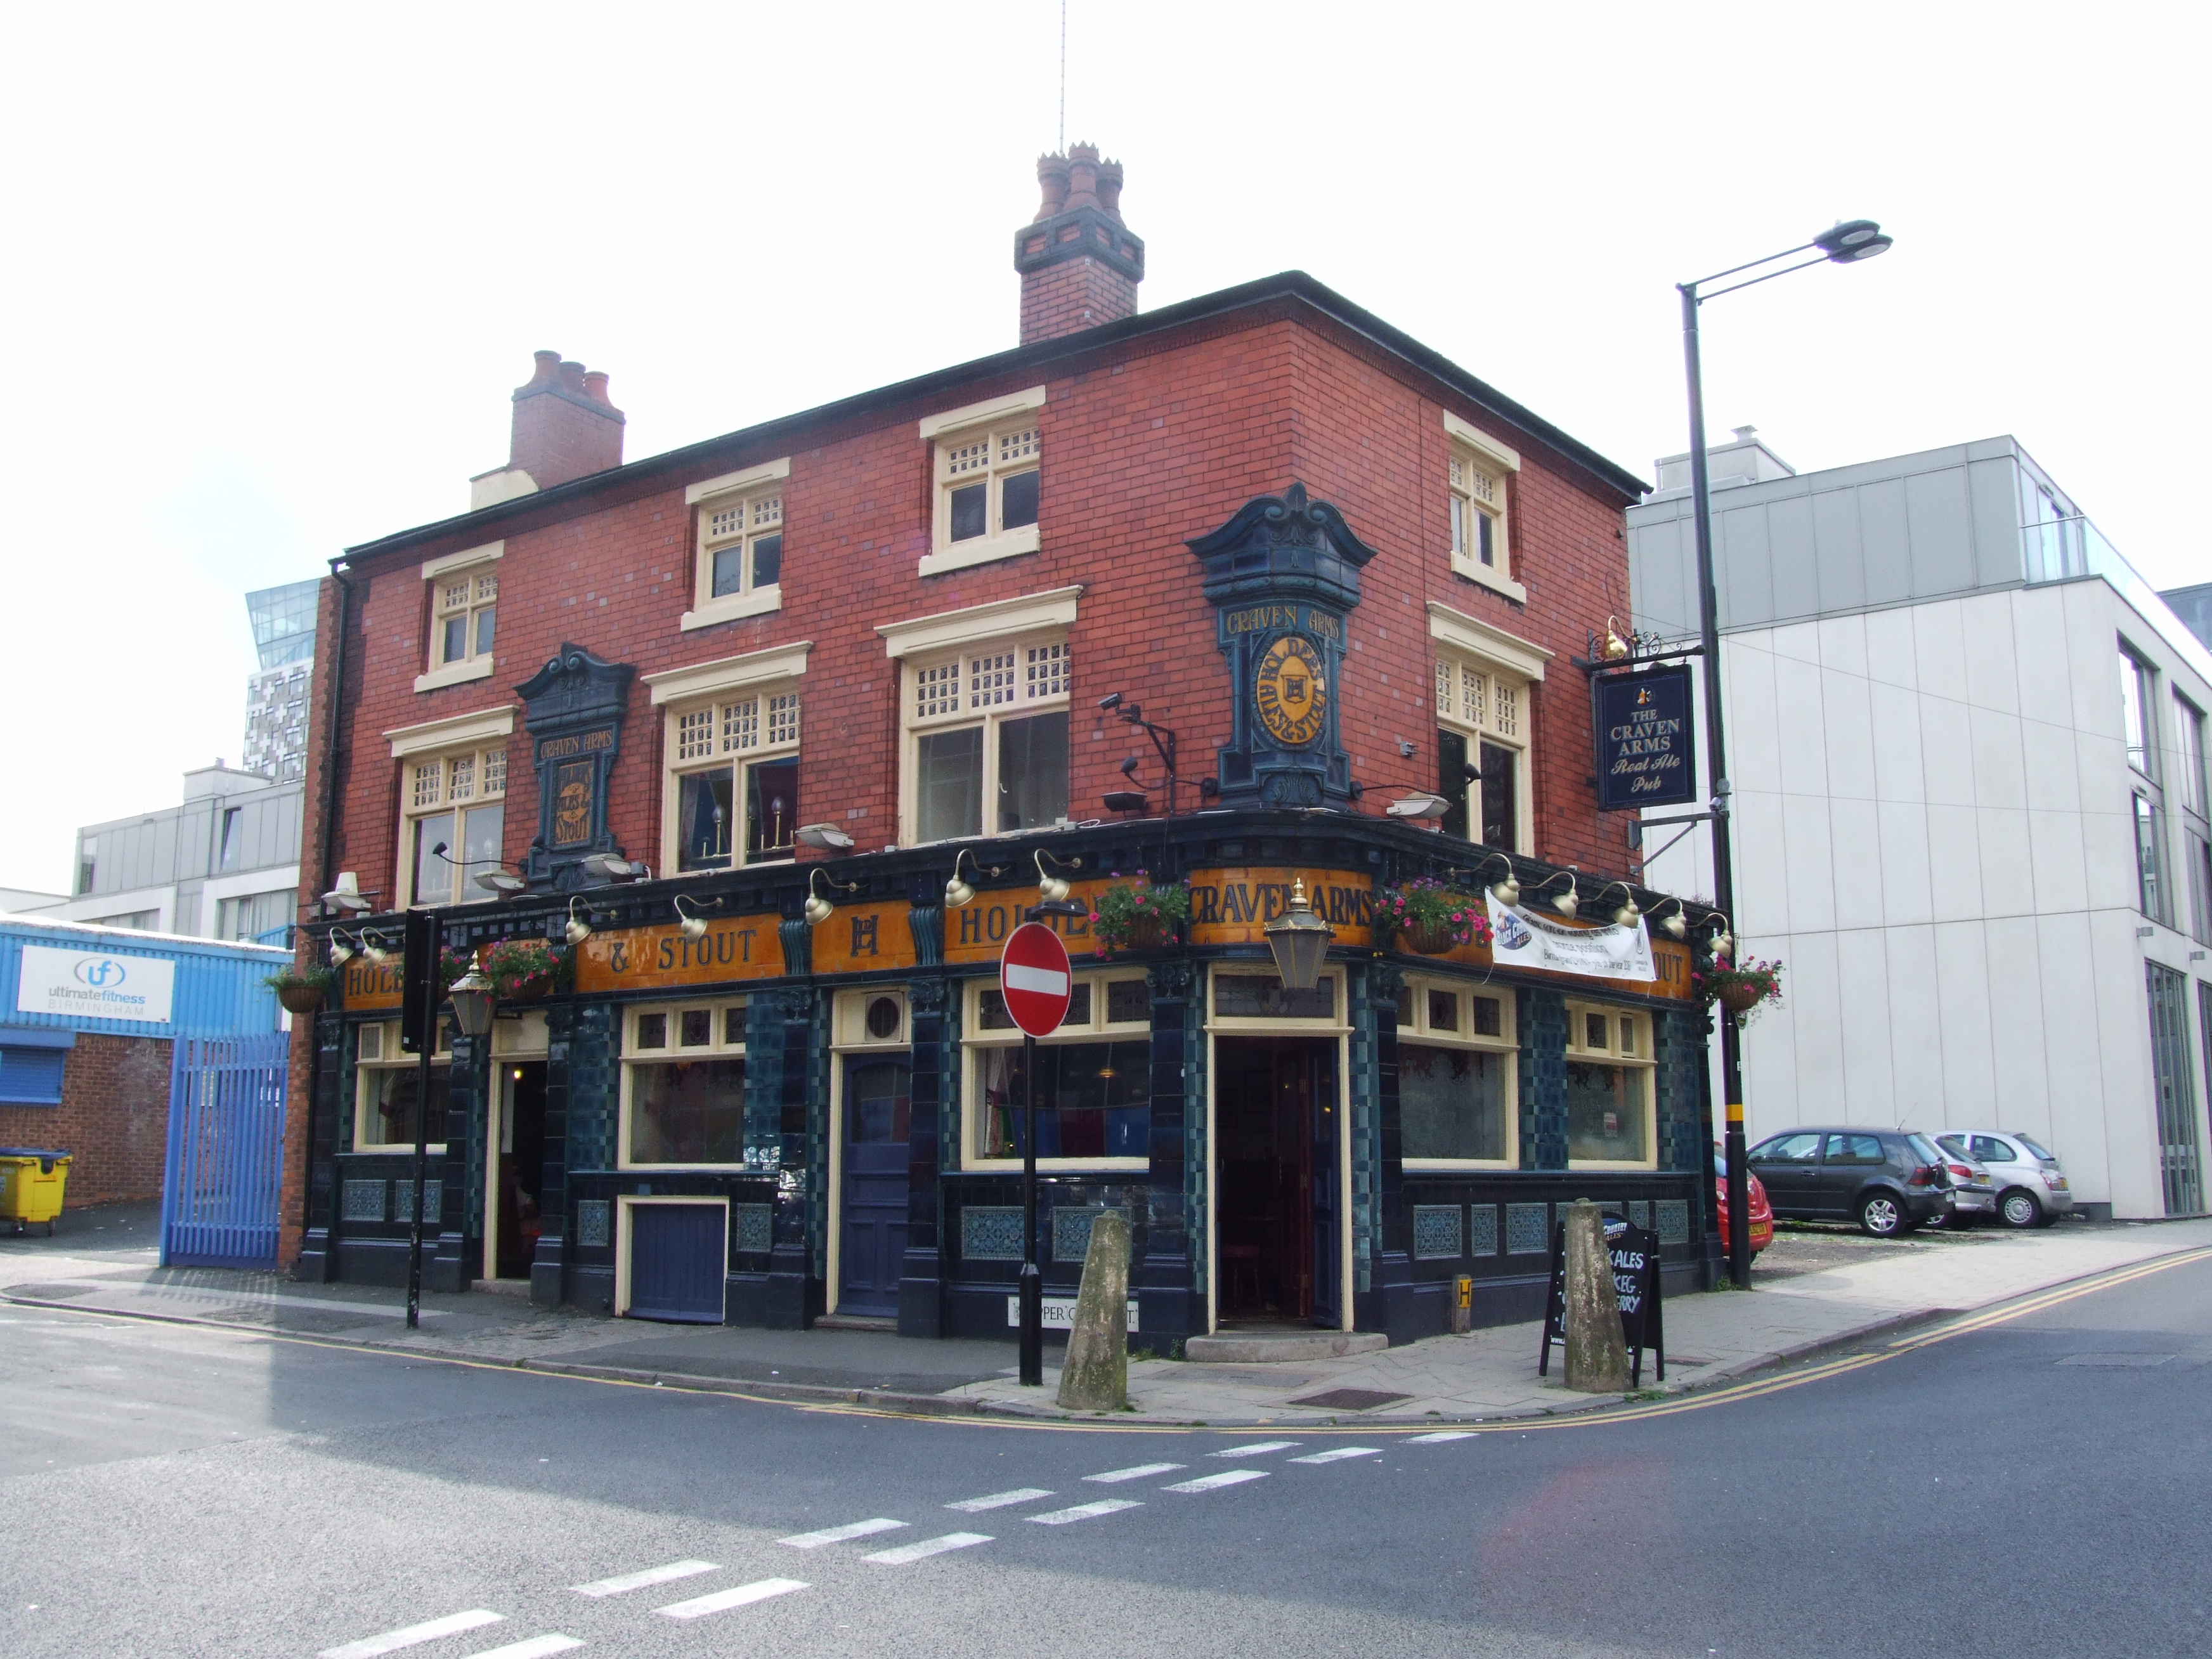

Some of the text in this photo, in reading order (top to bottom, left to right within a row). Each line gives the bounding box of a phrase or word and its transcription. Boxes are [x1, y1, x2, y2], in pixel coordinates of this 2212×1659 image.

[1227, 606, 1339, 639] CRAVEN ARMS
[1630, 709, 1658, 723] THE
[1610, 718, 1680, 742] CRAVEN
[541, 729, 613, 759] CRAVEN ARMS
[1618, 736, 1670, 757] ARMS
[1611, 753, 1680, 775] Real Ale
[1630, 775, 1661, 793] Pub
[1189, 884, 1372, 926] CRAVEN ARMS
[611, 930, 757, 973] & STOUT
[1653, 952, 1682, 984] OUT
[48, 999, 144, 1015] BIRMINGHAM
[1042, 1305, 1065, 1320] PER
